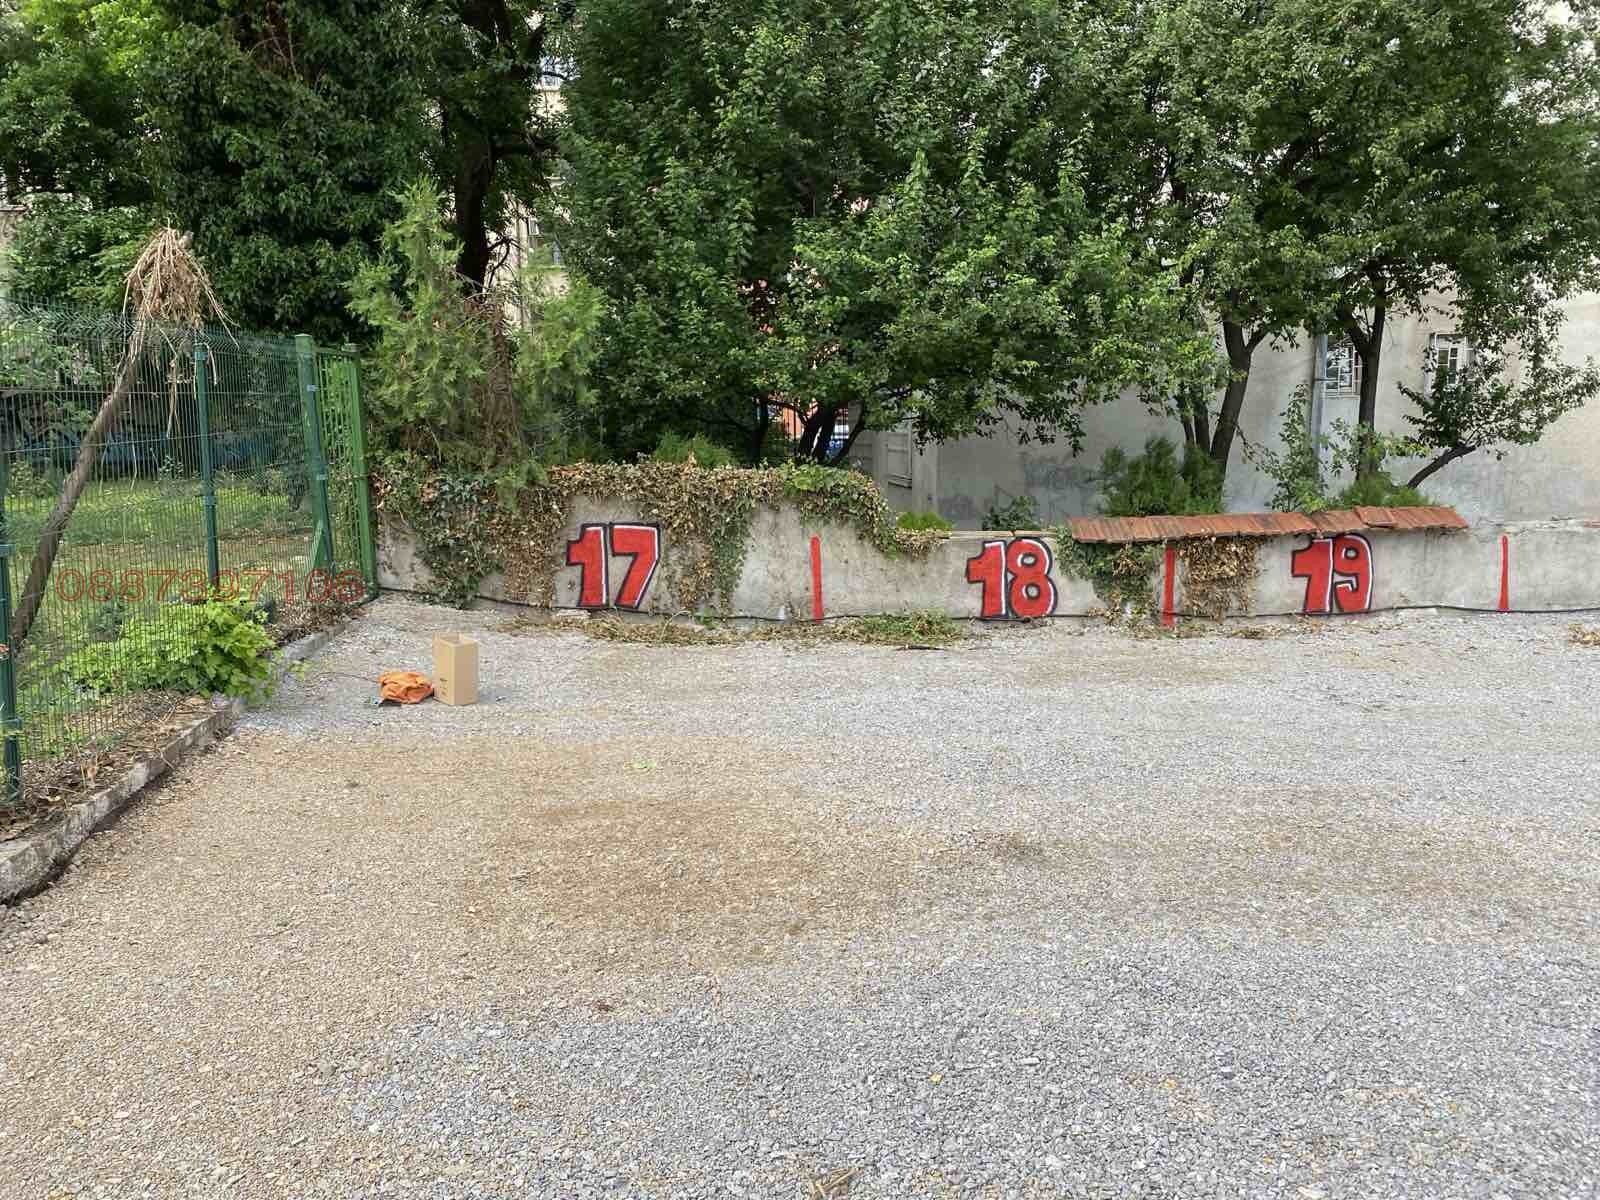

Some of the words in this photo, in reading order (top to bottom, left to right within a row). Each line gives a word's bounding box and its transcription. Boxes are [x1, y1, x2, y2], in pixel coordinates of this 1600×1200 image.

[566, 522, 660, 609] 17
[967, 537, 1057, 620] 18
[1291, 533, 1373, 614] 19
